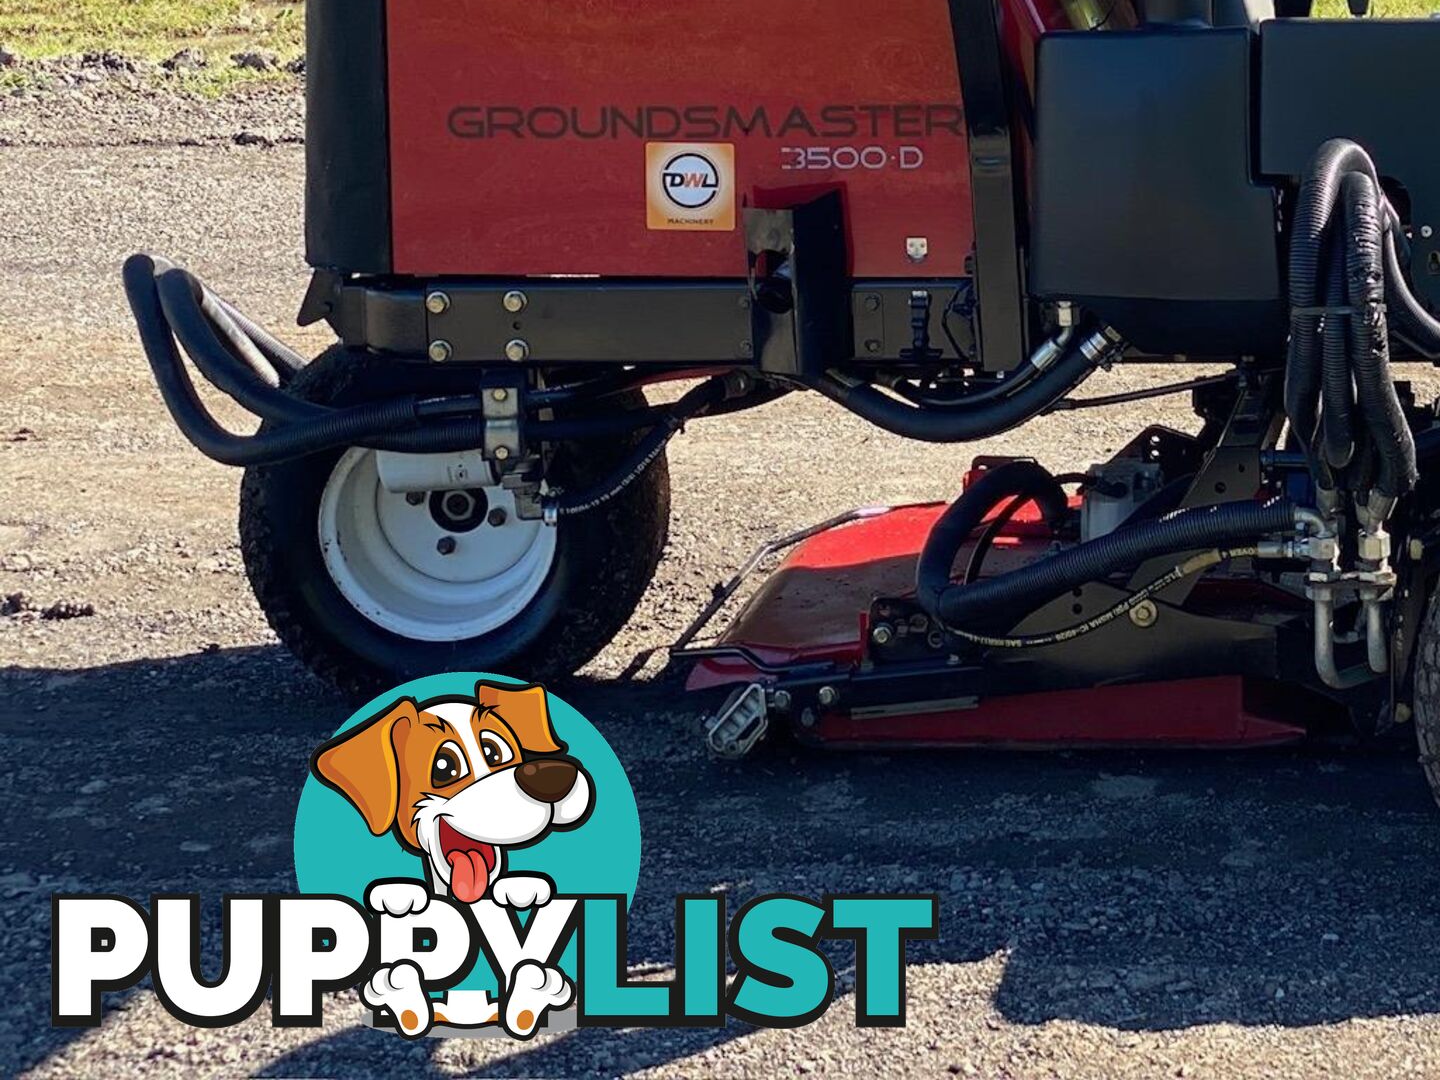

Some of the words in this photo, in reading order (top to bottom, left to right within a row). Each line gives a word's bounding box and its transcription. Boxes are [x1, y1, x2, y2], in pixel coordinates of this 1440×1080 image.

[448, 104, 963, 140] GROUNDSMASTER
[662, 173, 719, 187] DWL
[667, 218, 714, 226] MACHINERY
